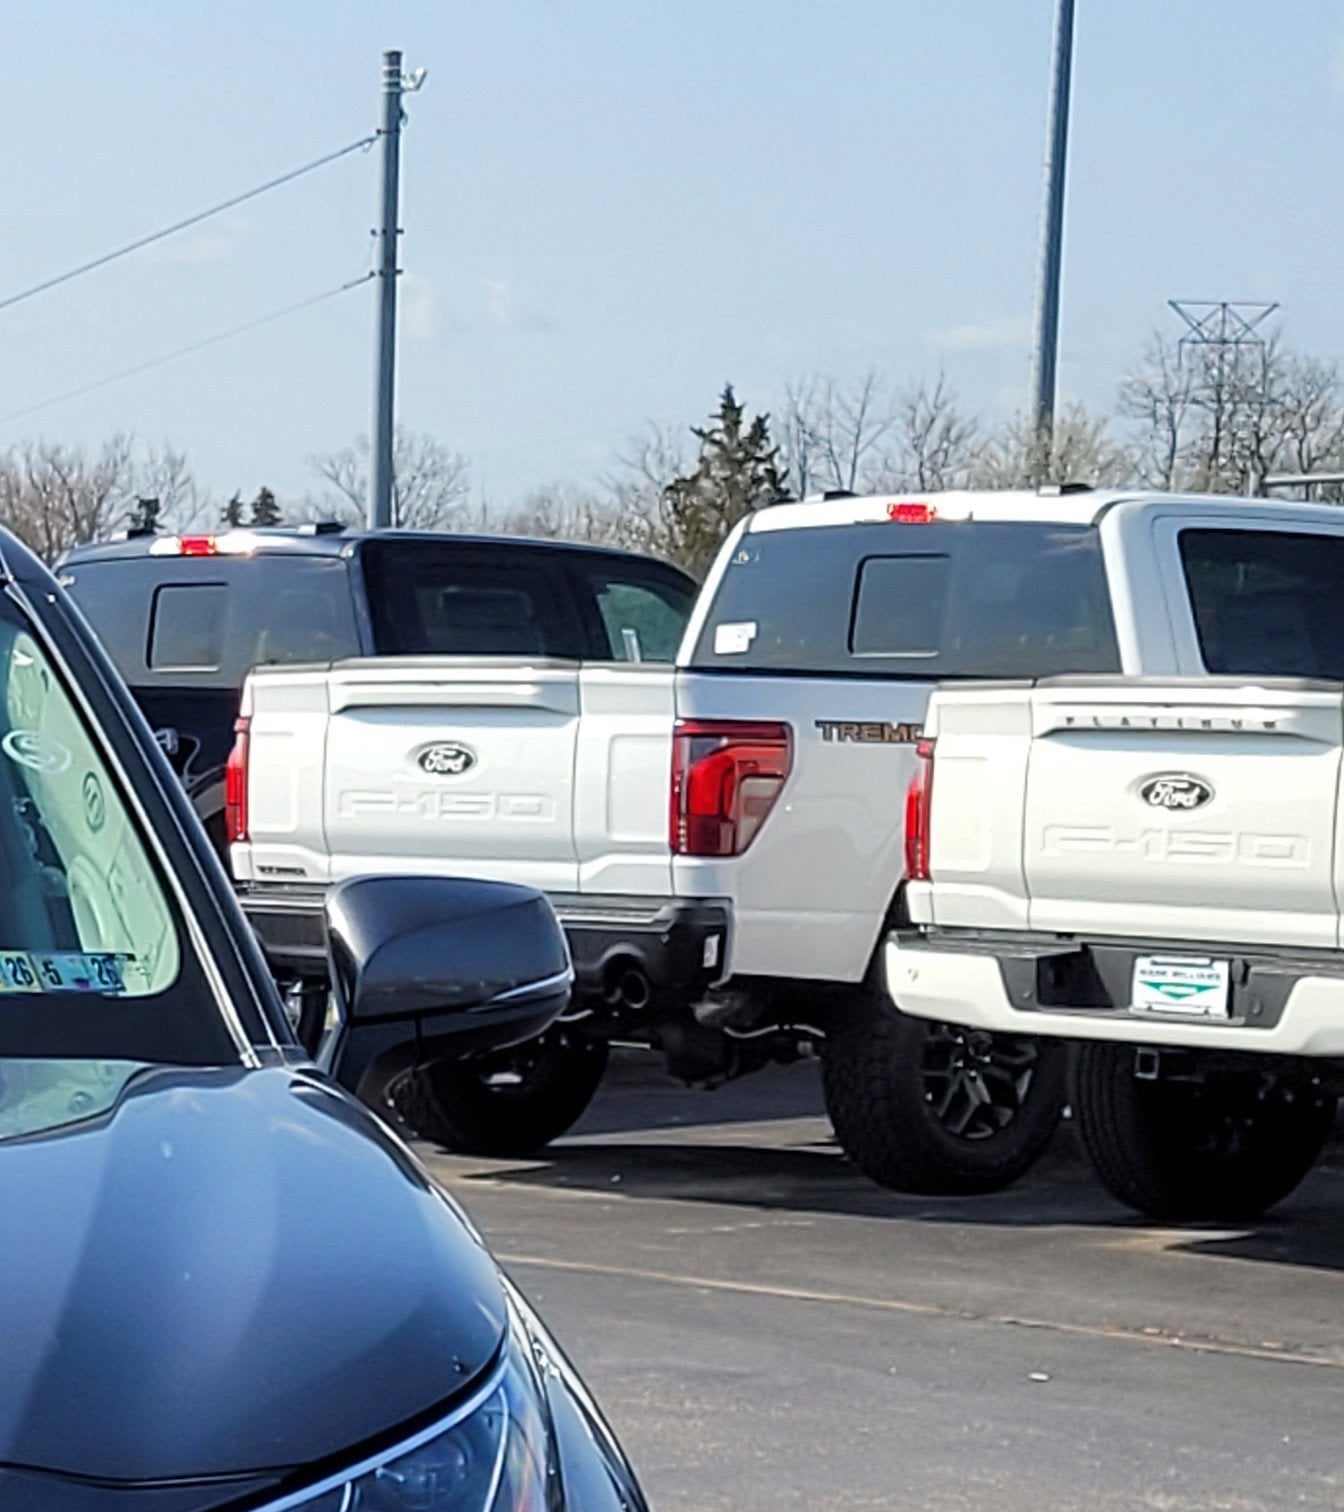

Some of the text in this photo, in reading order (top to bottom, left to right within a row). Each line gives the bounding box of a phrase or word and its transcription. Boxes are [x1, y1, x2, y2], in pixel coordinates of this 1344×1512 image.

[337, 788, 557, 821] F-150
[1146, 778, 1204, 809] Ford
[1039, 824, 1312, 870] F-150
[4, 956, 35, 986] 26
